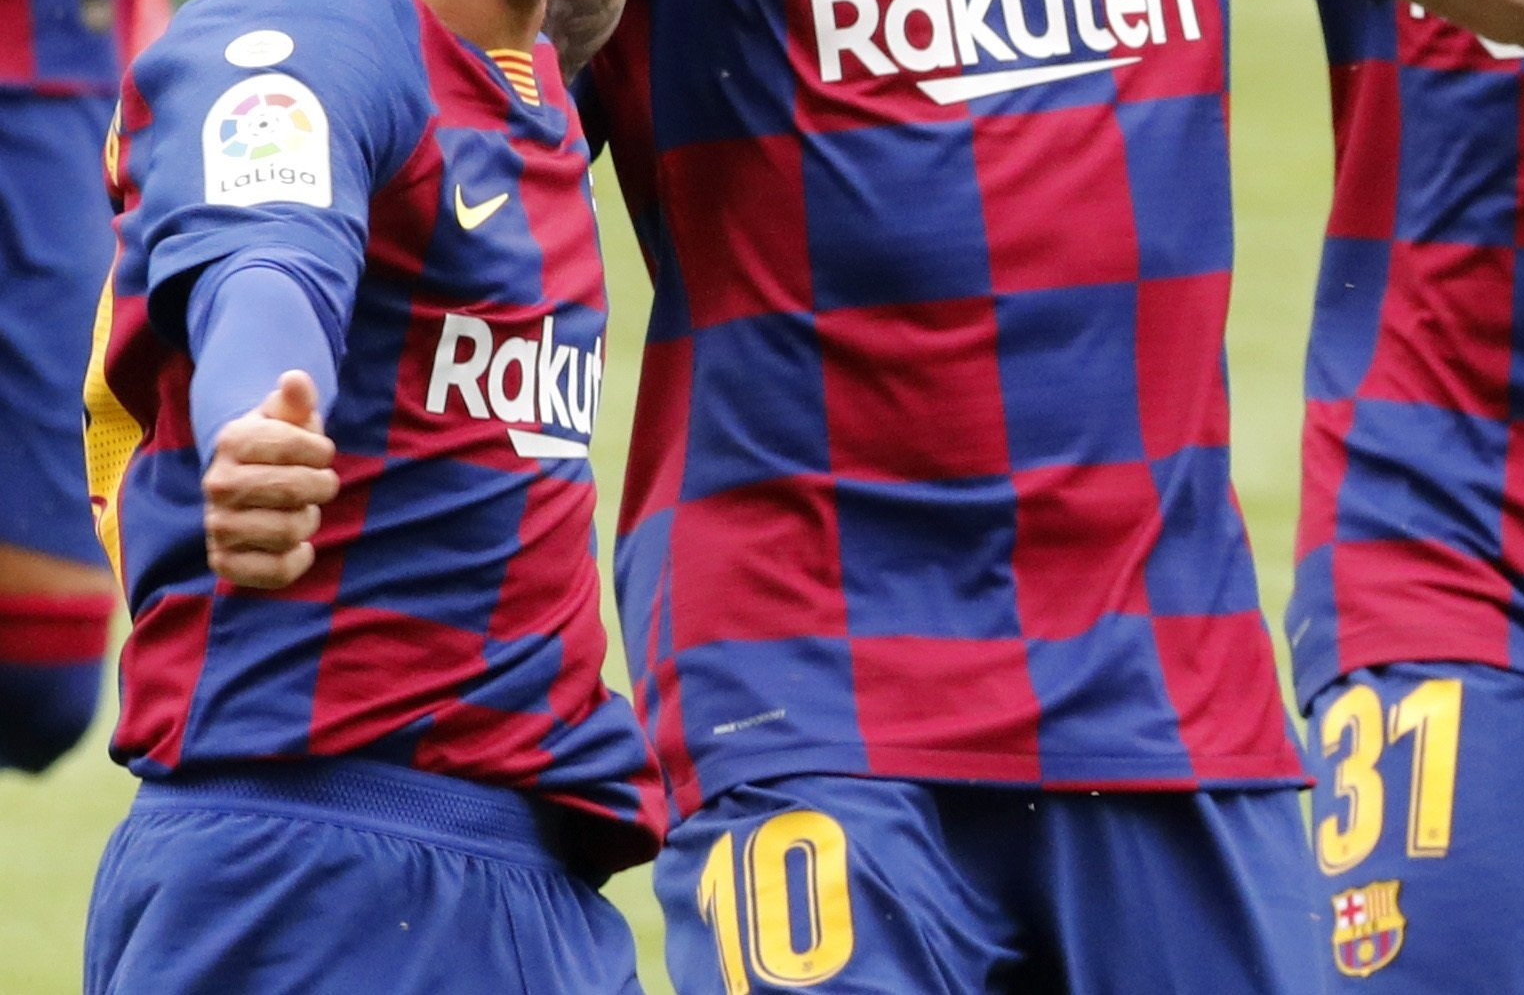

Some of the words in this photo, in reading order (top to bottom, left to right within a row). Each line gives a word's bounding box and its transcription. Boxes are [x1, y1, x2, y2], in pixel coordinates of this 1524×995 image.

[220, 163, 316, 193] LaLiga
[1315, 678, 1464, 877] 31
[696, 809, 856, 995] 10
